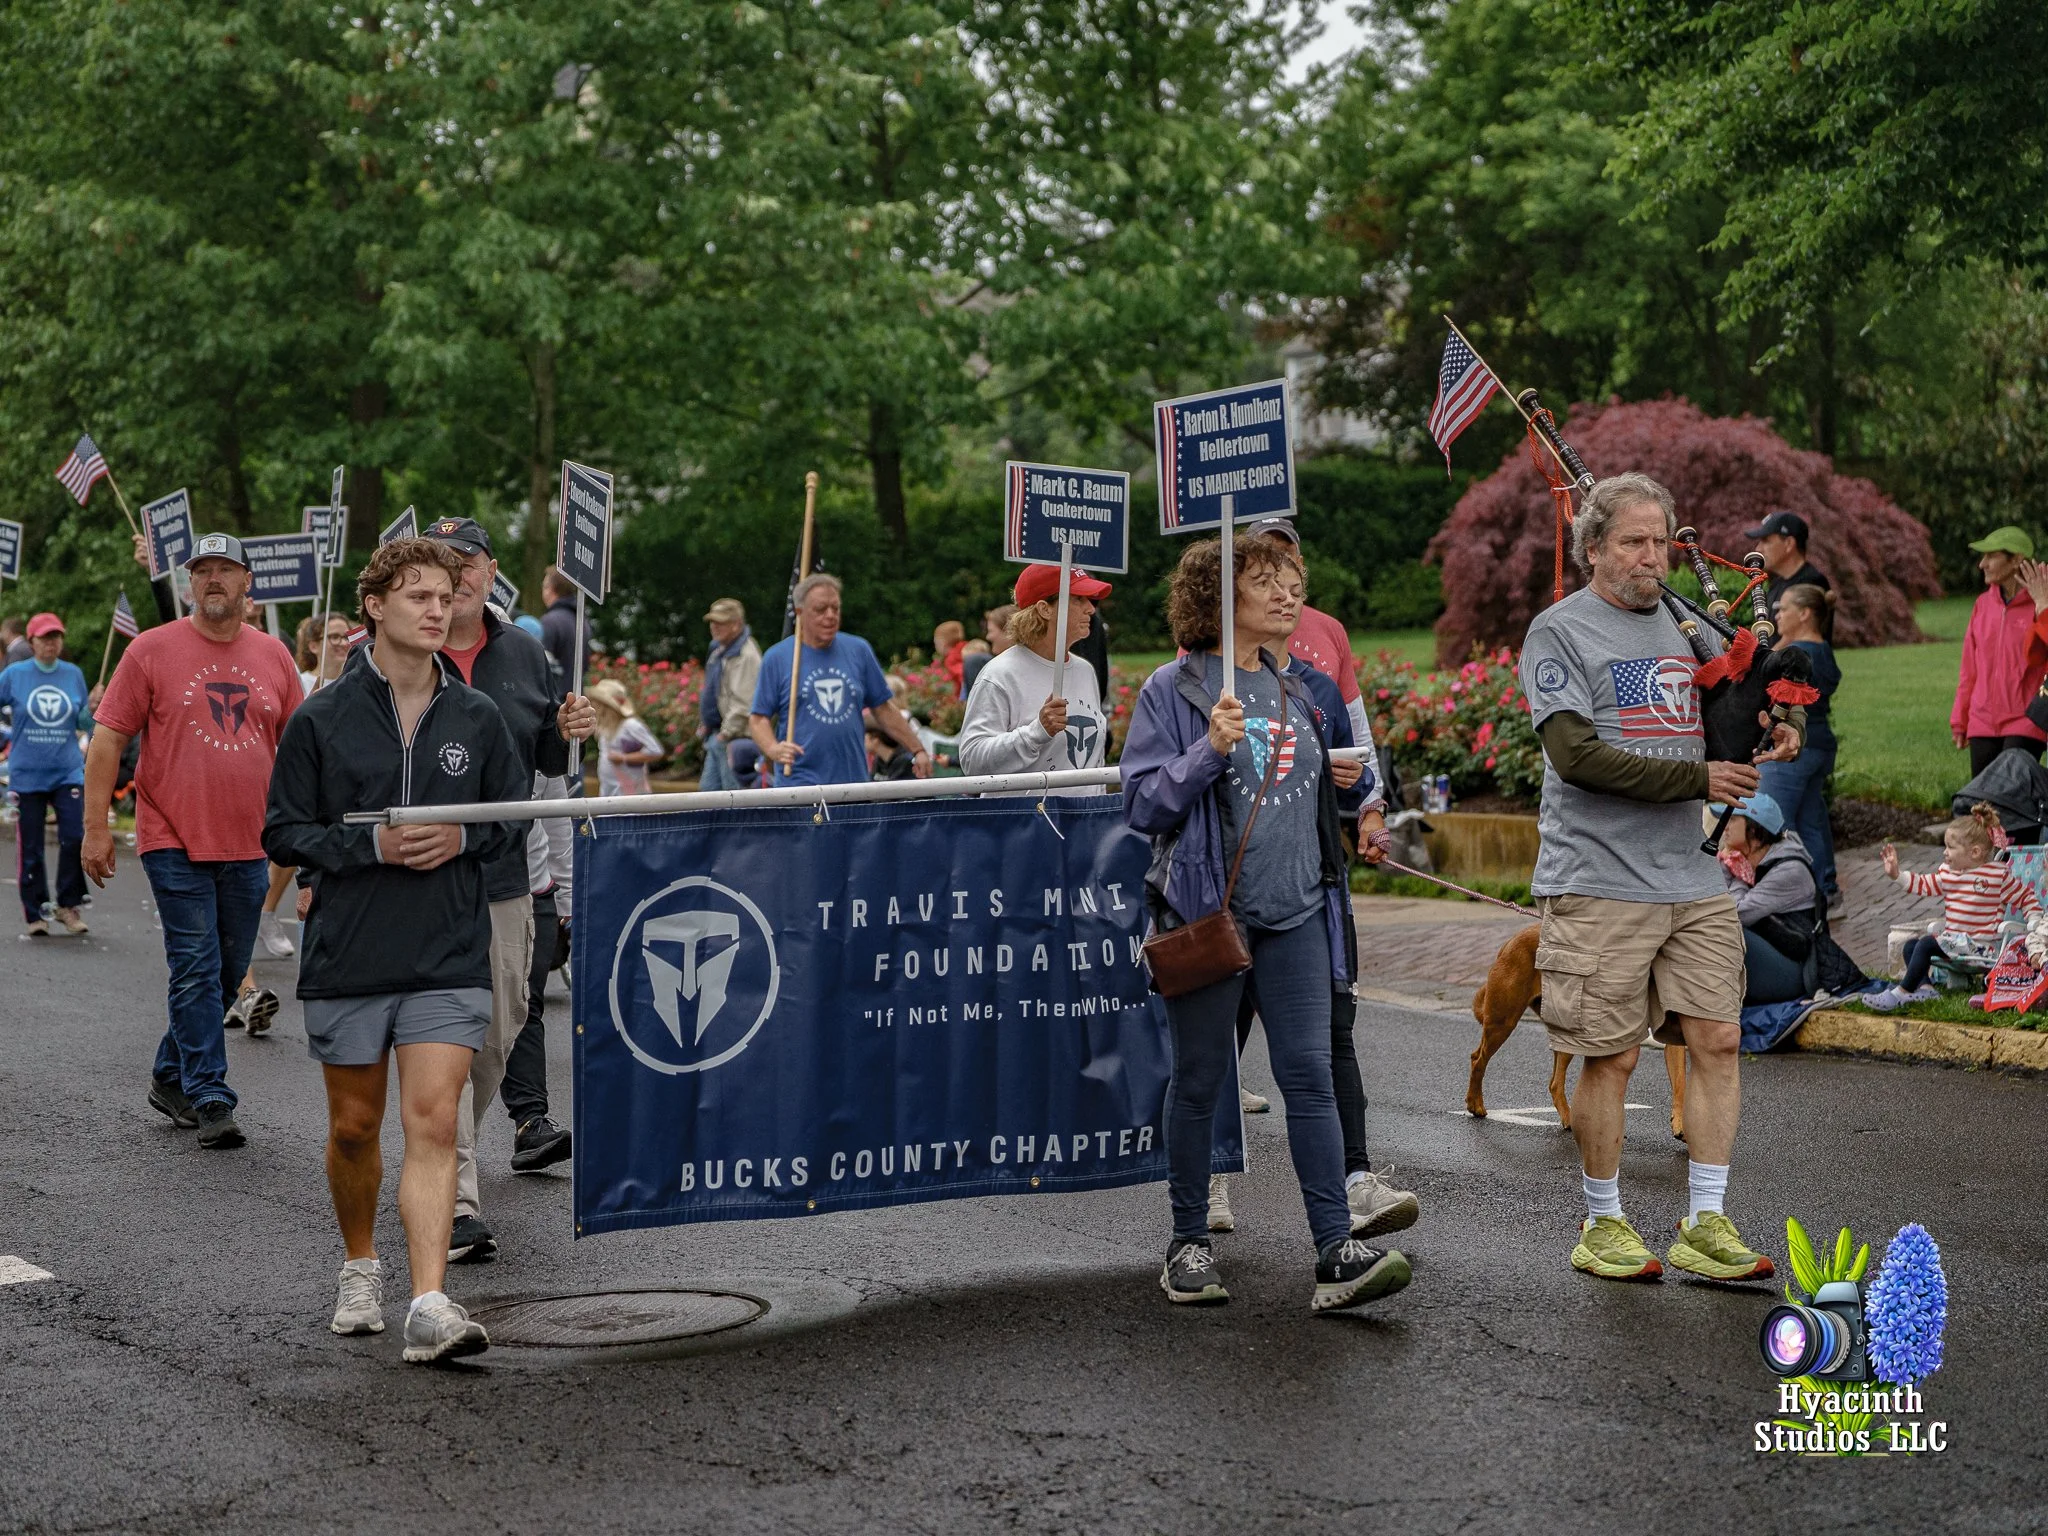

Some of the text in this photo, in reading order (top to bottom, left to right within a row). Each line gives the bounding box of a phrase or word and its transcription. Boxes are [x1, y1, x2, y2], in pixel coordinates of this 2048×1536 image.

[1184, 398, 1282, 436] Barton R. Humlhanz
[1200, 433, 1269, 462] Hellertown
[1031, 474, 1123, 502] Mark C. Baum
[1188, 463, 1285, 499] US MARINE CORPS
[1041, 500, 1112, 522] Quakertown
[246, 545, 273, 559] urice
[274, 543, 313, 557] Johnson
[1051, 527, 1101, 547] US ARMY
[251, 558, 300, 572] Levittown
[255, 574, 299, 590] US ARMY
[1295, 641, 1332, 675] MANIO
[183, 664, 218, 706] TRAVIS
[1270, 699, 1321, 755] MNION
[1623, 747, 1683, 757] TRAVIS
[1226, 766, 1317, 806] FOUNDATION
[817, 888, 1004, 931] TRAVIS
[873, 934, 1142, 983] FOUNDATION
[908, 1005, 948, 1026] Not
[963, 1003, 1004, 1022] Me,
[680, 1125, 1155, 1193] BUCKS COUNTY CHAPTER
